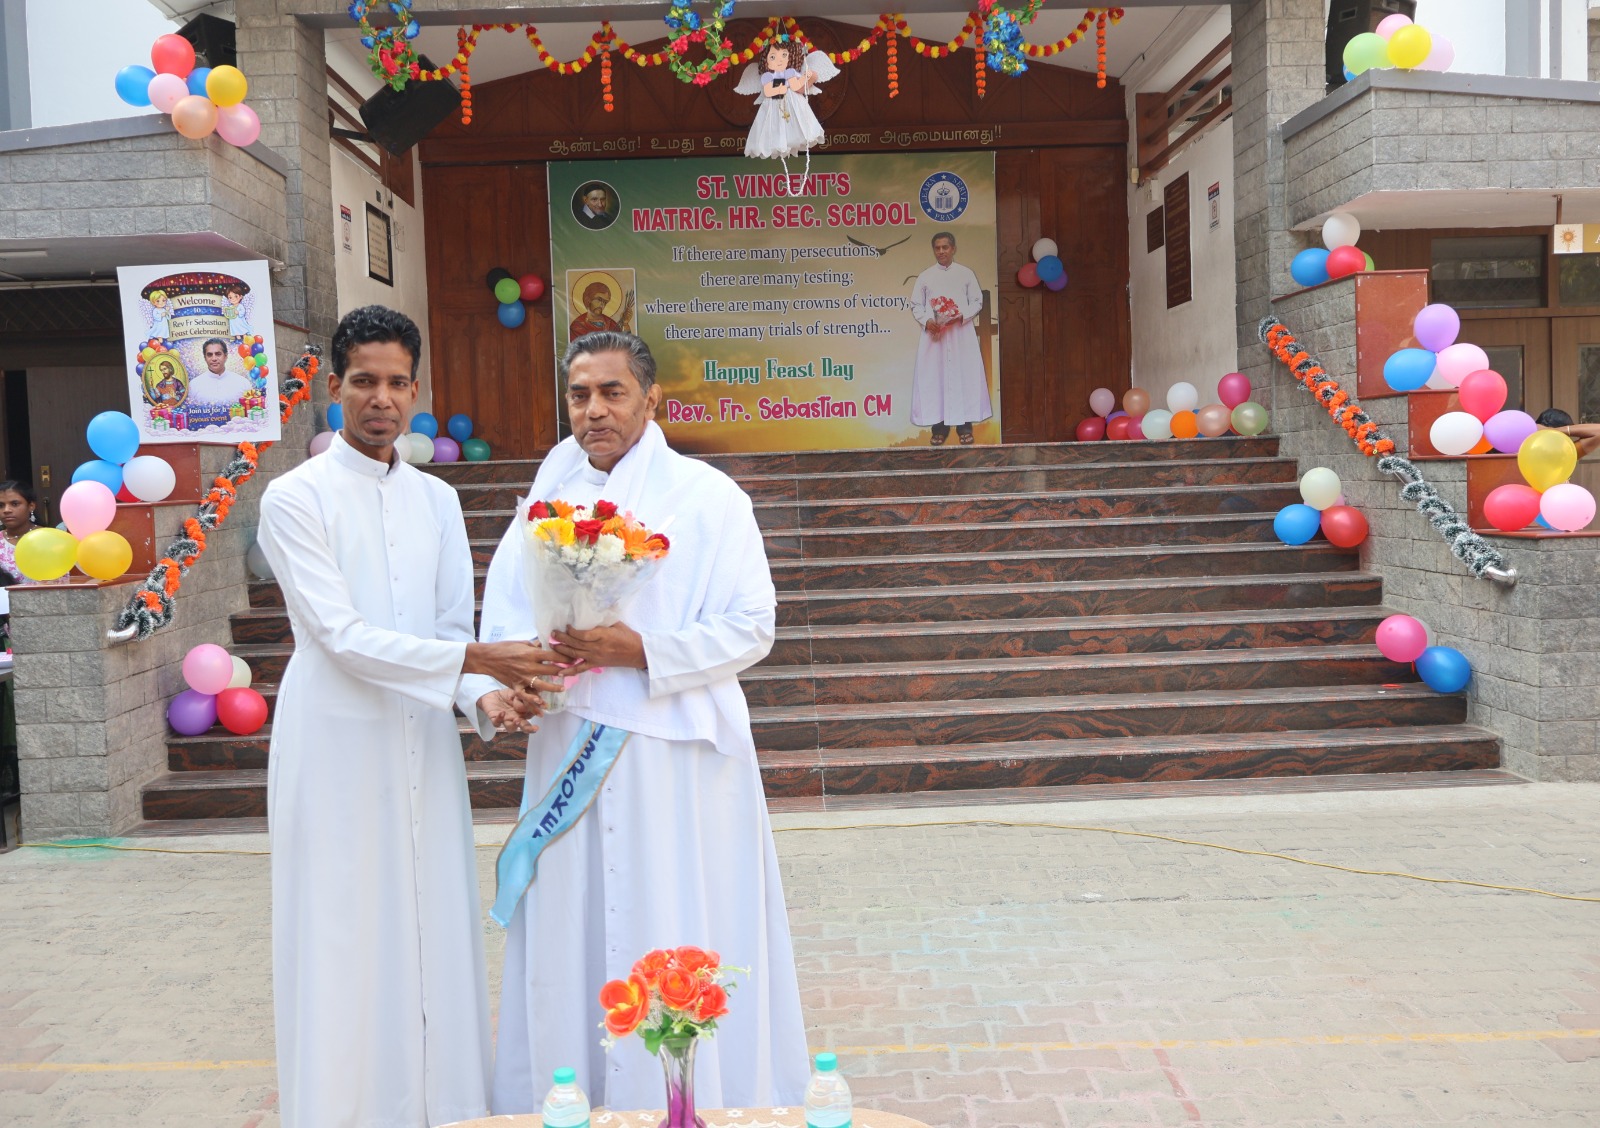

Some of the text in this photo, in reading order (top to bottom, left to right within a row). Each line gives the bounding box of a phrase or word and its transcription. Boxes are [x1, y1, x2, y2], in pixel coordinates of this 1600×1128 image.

[549, 136, 641, 156] ஆண்டவரே!
[651, 138, 695, 153] உமது
[880, 125, 1002, 146] அருமையானது!!
[697, 172, 851, 199] ST. VINCENT'S
[921, 177, 936, 204] LEARN
[952, 177, 967, 203] SERVE
[632, 202, 917, 232] MATRIC. HR. SEC. SCHOOL
[934, 213, 955, 221] PRAY
[673, 243, 879, 262] If there are many persecutions,
[700, 270, 854, 287] there are many testing;
[177, 297, 216, 306] Welcome
[645, 294, 909, 314] where there are many crowns of victory,
[194, 317, 227, 326] Sebastian
[665, 319, 891, 340] there are many trials of strength...
[171, 328, 229, 338] Feast Celebration!
[704, 357, 854, 384] Happy Feast Day
[211, 406, 221, 415] for
[667, 399, 712, 423] Rev.
[719, 398, 751, 421] Fr.
[863, 394, 892, 417] CM
